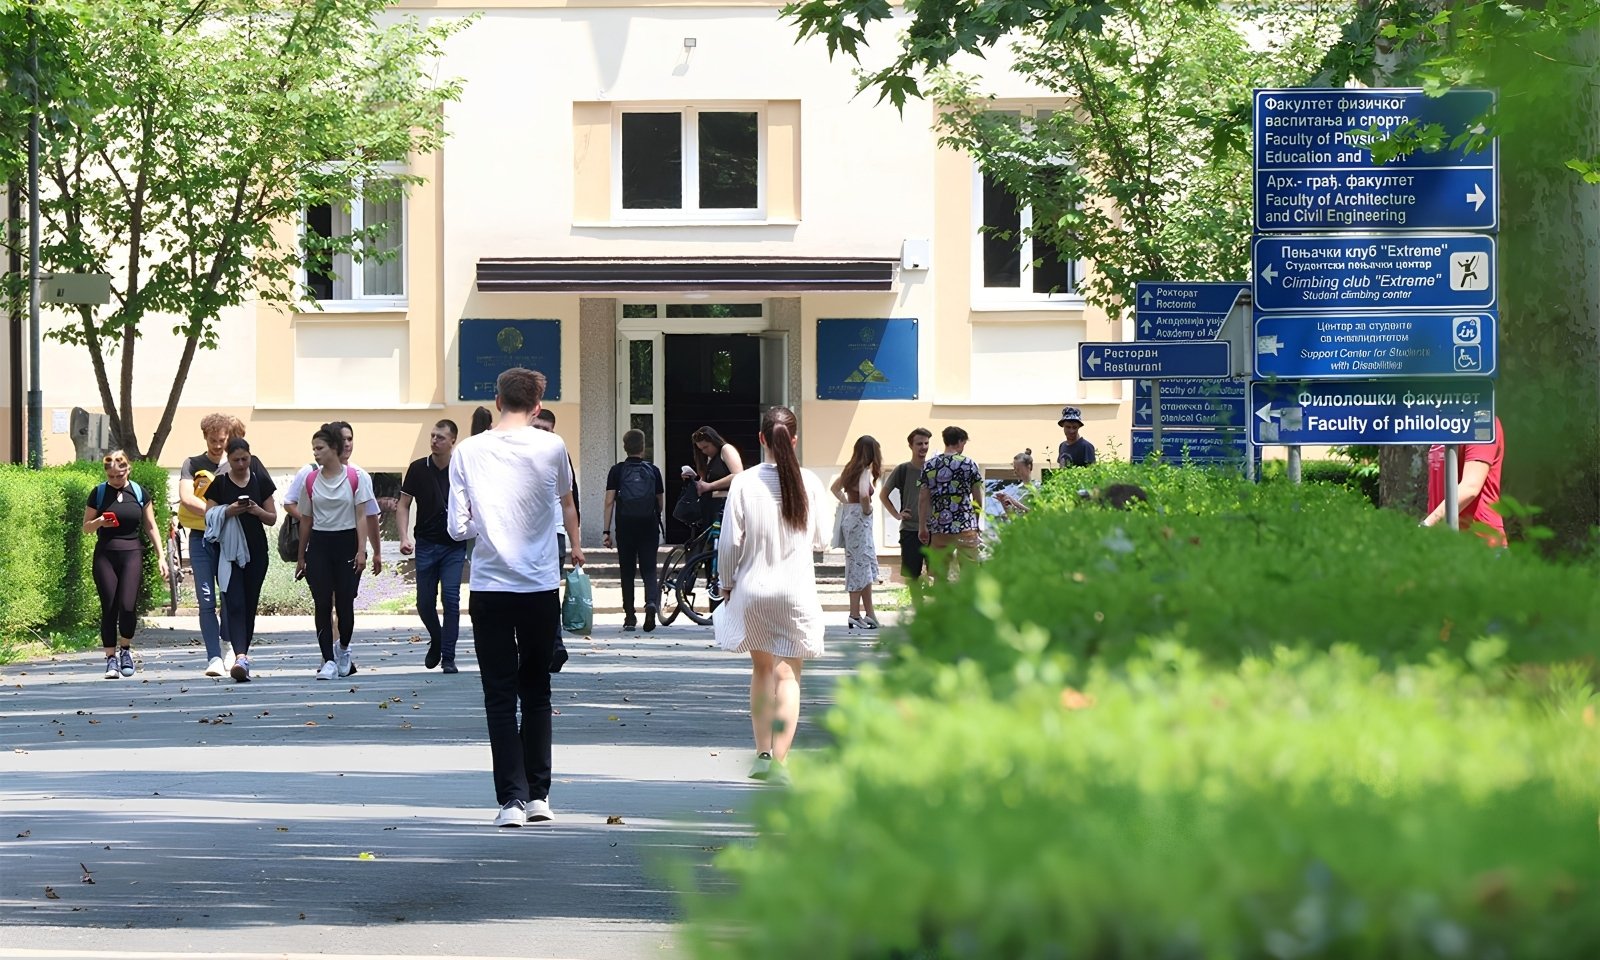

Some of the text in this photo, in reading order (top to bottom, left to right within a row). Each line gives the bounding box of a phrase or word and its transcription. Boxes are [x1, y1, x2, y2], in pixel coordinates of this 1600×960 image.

[1264, 97, 1406, 112] Факултет физичког
[1265, 115, 1408, 129] васпитања и спорта
[1265, 132, 1314, 147] Faculty
[1317, 132, 1330, 145] of
[1265, 151, 1331, 163] Education
[1337, 150, 1361, 162] and
[1306, 174, 1341, 190] грађ.
[1346, 173, 1414, 188] факултет
[1265, 193, 1416, 207] Faculty of Architecture
[1265, 209, 1406, 224] and Civil Engineering
[1282, 244, 1448, 260] Пењачки клуб "Extreme"
[1286, 261, 1345, 270] Студентски
[1396, 261, 1432, 270] центар
[1283, 274, 1442, 290] Climbing club "Extreme"
[1156, 288, 1198, 298] Ректорат
[1303, 290, 1412, 300] Student climbing center
[1317, 322, 1353, 332] Центар
[1156, 329, 1195, 339] Academy
[1197, 329, 1206, 337] of
[1104, 349, 1158, 360] Ресторан
[1301, 349, 1338, 360] Support
[1373, 348, 1386, 357] for
[1104, 362, 1162, 371] Restaurant
[1331, 361, 1349, 370] with
[1160, 386, 1185, 395] aculty
[1298, 390, 1480, 408] Филолошки факултет
[1160, 413, 1194, 422] otanical
[1308, 416, 1471, 433] Faculty of philology
